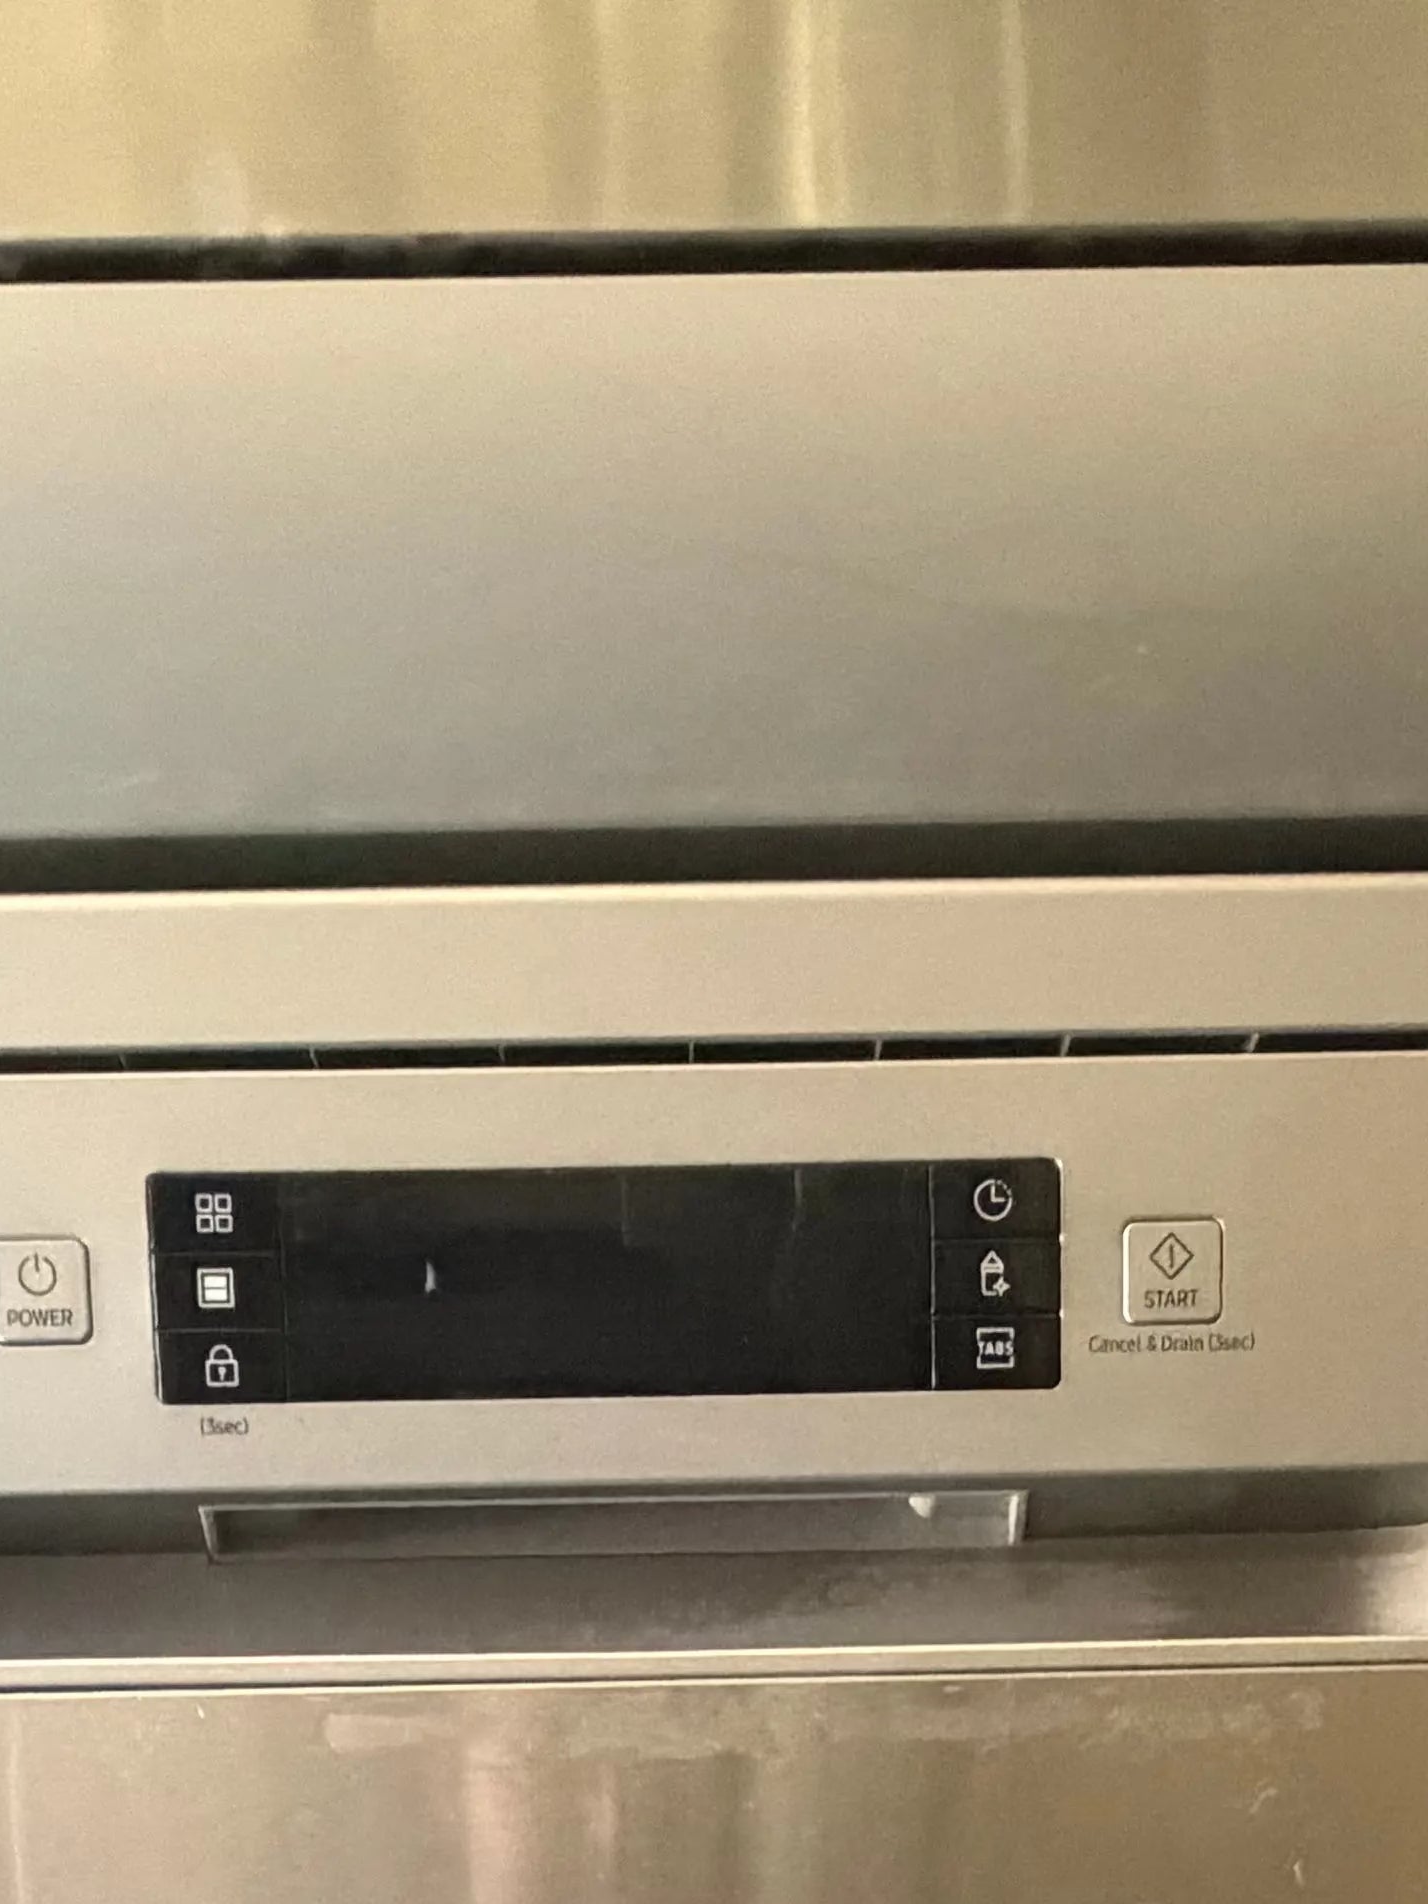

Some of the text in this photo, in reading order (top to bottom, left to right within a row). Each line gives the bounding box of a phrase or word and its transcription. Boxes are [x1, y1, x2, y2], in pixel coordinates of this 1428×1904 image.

[1144, 1288, 1198, 1309] START
[6, 1308, 73, 1329] POWER
[1089, 1334, 1142, 1353] Cancel
[1146, 1335, 1157, 1352] &
[1161, 1334, 1204, 1352] Drain
